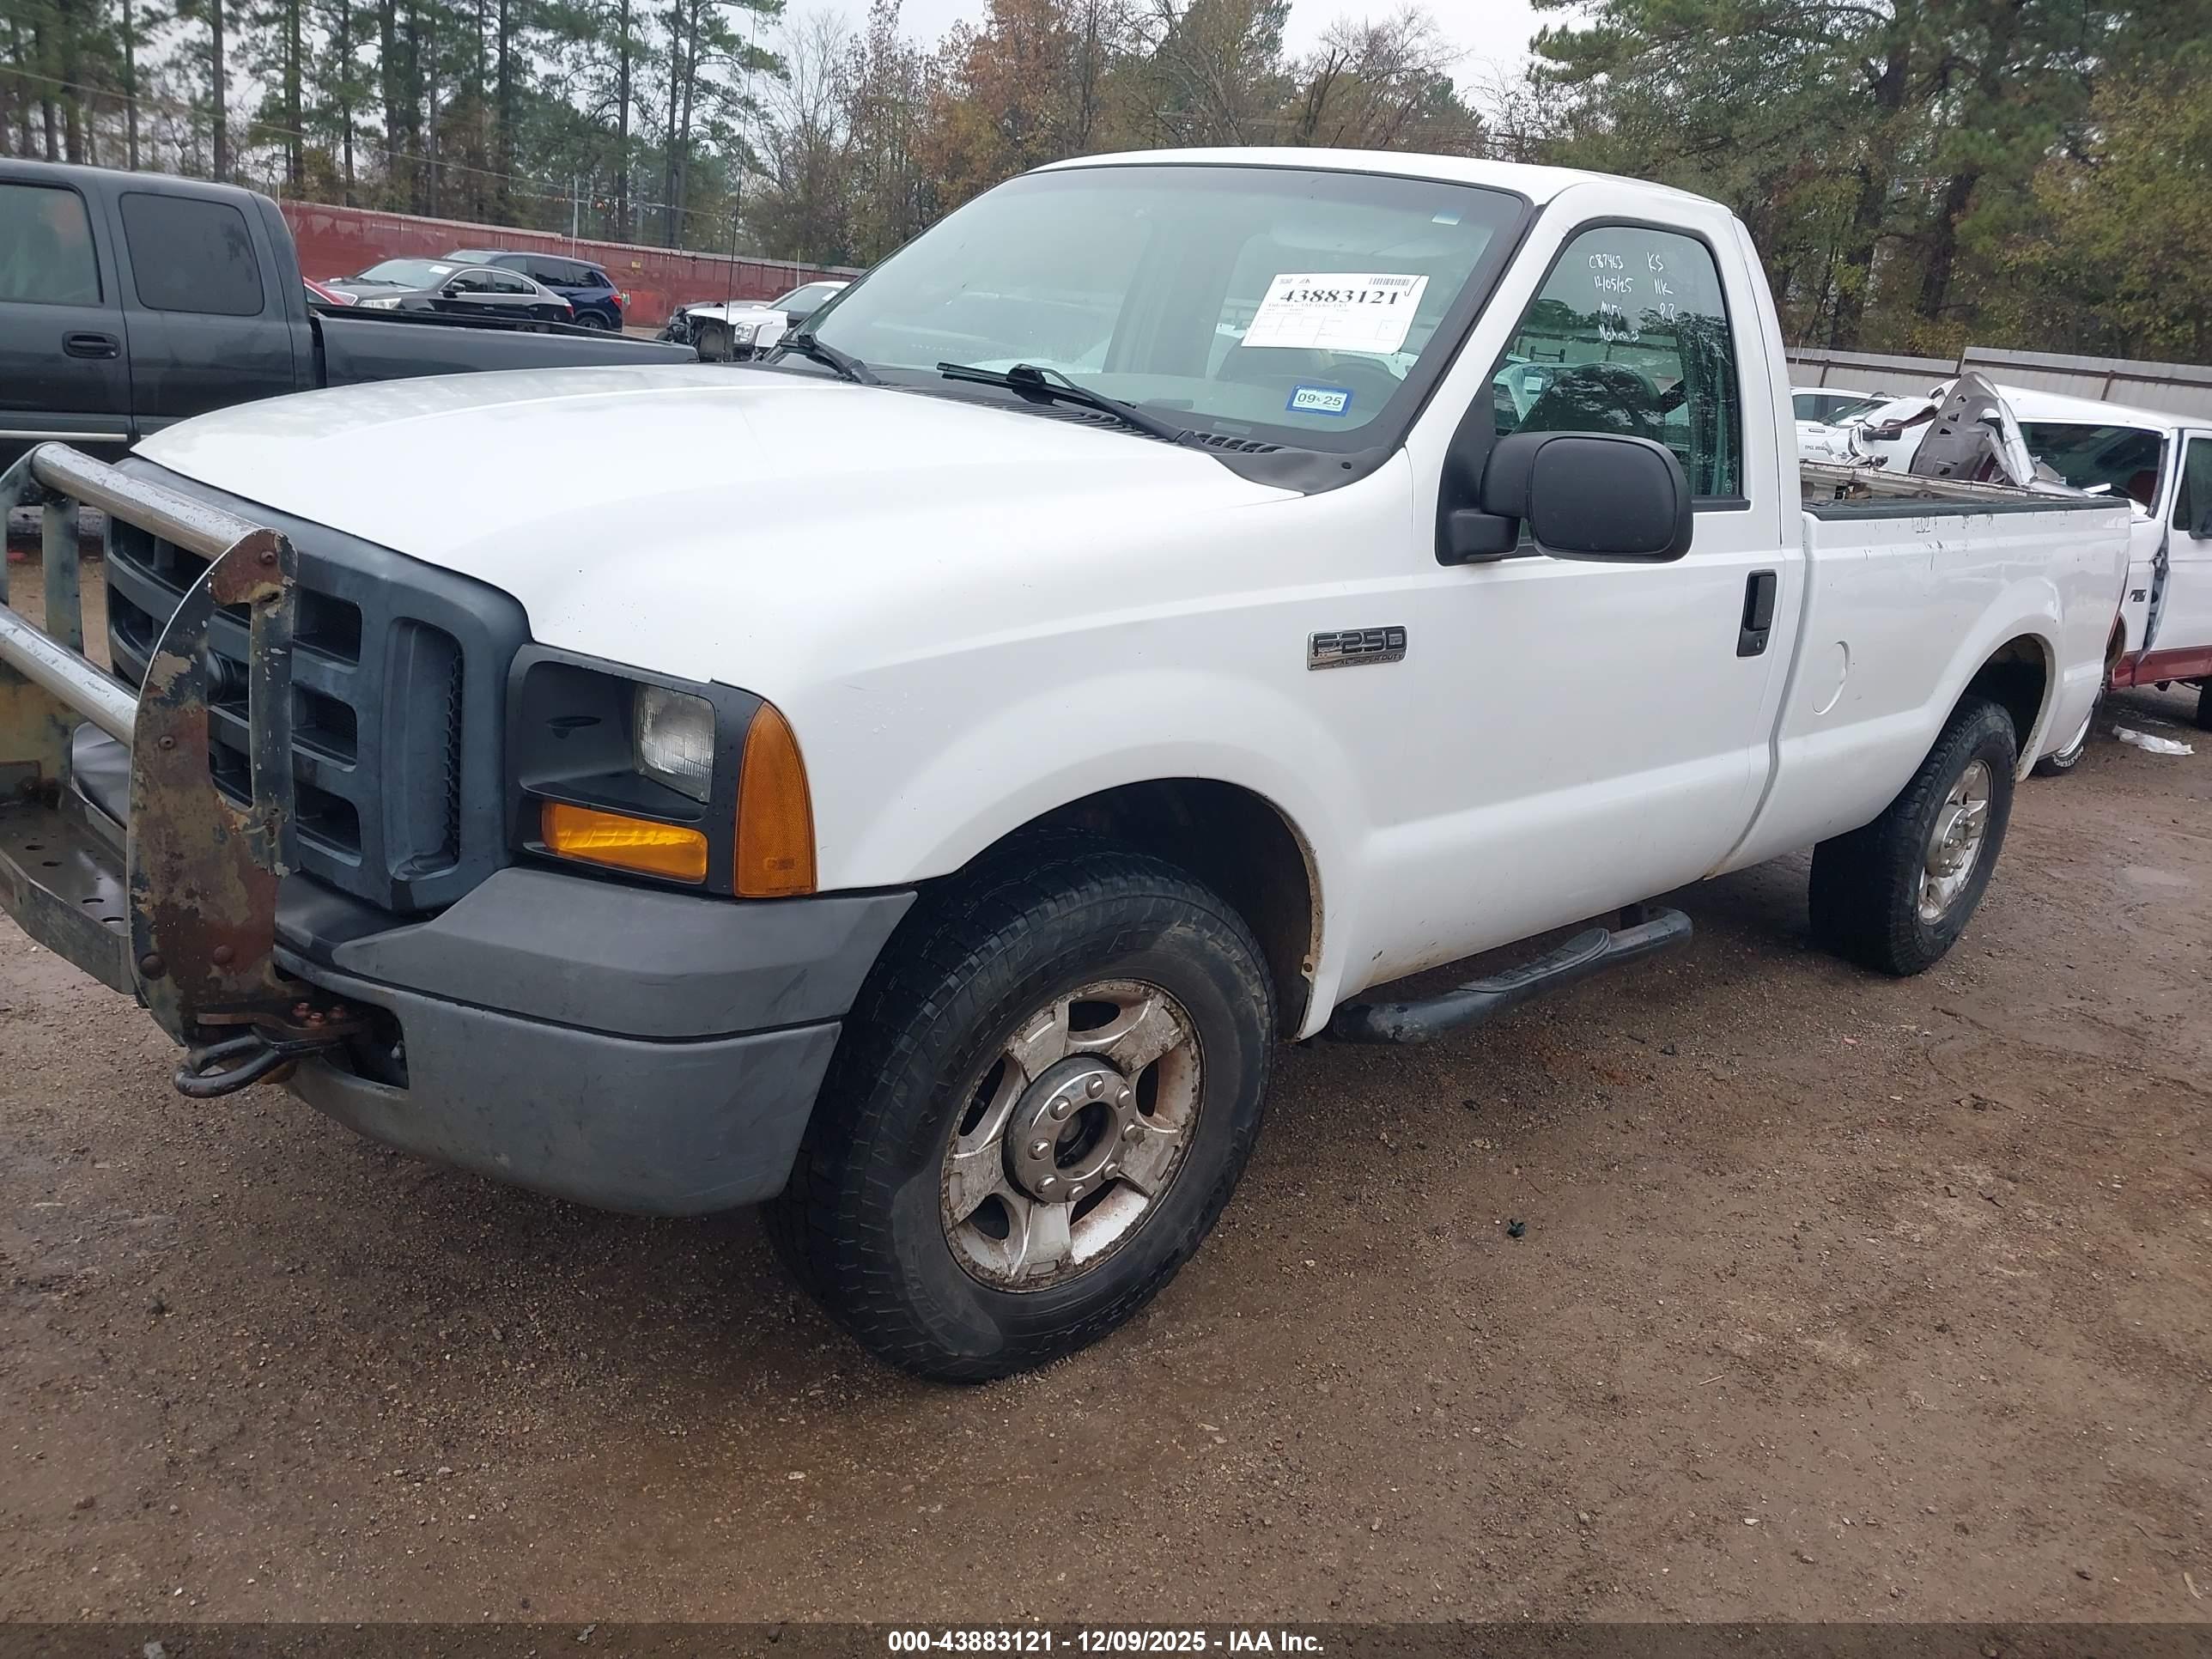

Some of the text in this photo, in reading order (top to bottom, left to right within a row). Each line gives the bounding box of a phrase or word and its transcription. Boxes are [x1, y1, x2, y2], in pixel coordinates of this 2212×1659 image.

[1280, 289, 1399, 305] 43883121
[1297, 392, 1343, 406] 09 25
